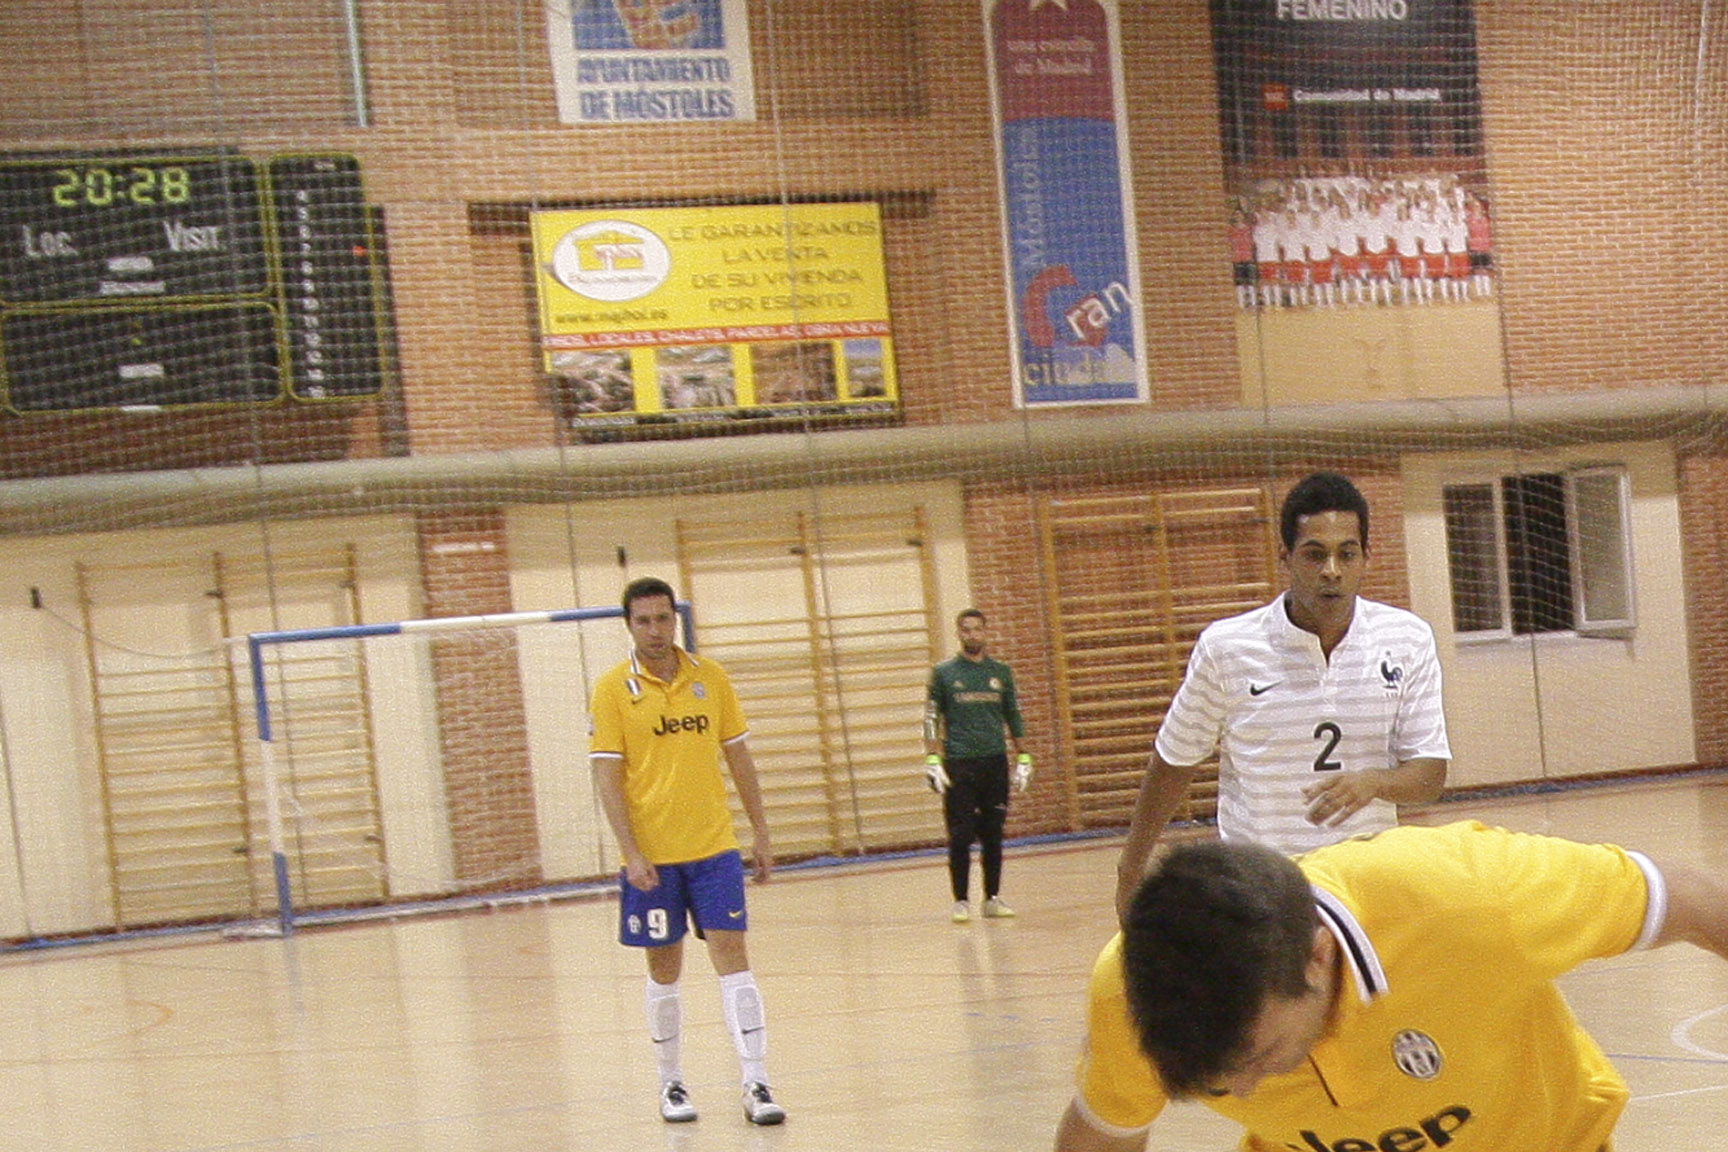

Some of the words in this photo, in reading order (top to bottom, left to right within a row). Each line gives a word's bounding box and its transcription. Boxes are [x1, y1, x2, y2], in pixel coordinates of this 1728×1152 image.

[1276, 0, 1408, 20] FEMENINO
[580, 90, 610, 119] DE
[53, 166, 190, 208] 20:28
[669, 225, 696, 242] LE
[722, 248, 752, 264] LA
[755, 245, 829, 262] VENTA
[691, 273, 722, 289] DE
[727, 272, 757, 288] SU
[763, 269, 864, 285] VIVIENDA
[709, 297, 754, 312] POR
[759, 293, 852, 309] ESCRITO
[652, 714, 709, 736] Jeep
[1313, 722, 1342, 771] 2
[647, 908, 668, 939] 9
